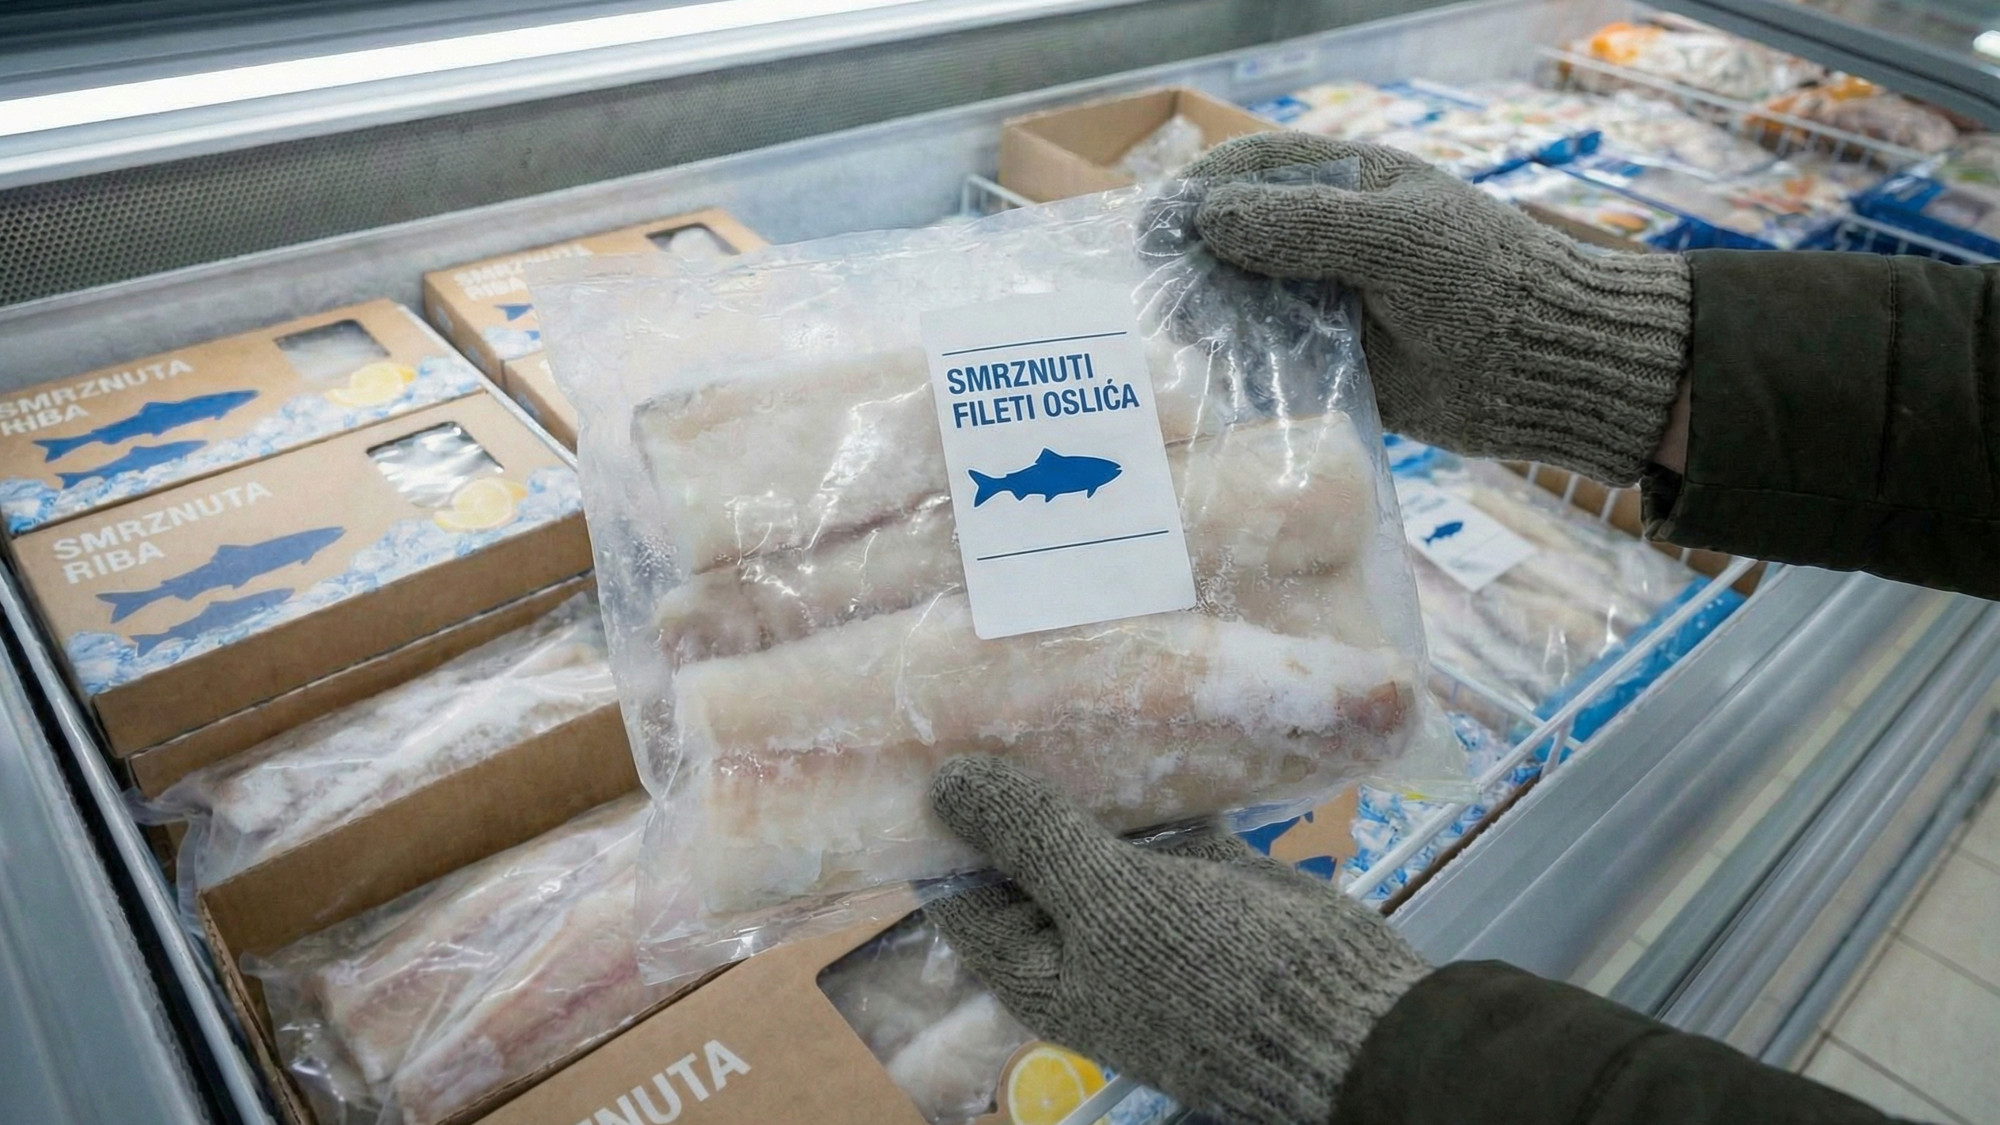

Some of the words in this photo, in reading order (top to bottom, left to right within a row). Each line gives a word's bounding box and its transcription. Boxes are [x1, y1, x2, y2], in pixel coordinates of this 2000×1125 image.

[0, 359, 194, 420] SMRZNUTA
[946, 353, 1094, 395] SMRZNUTI
[952, 394, 1036, 429] FILETI
[1043, 378, 1140, 418] OSLIĆA
[53, 481, 273, 561] SMRZNUTA
[62, 540, 166, 585] RIBA
[574, 1039, 752, 1125] NUTA
